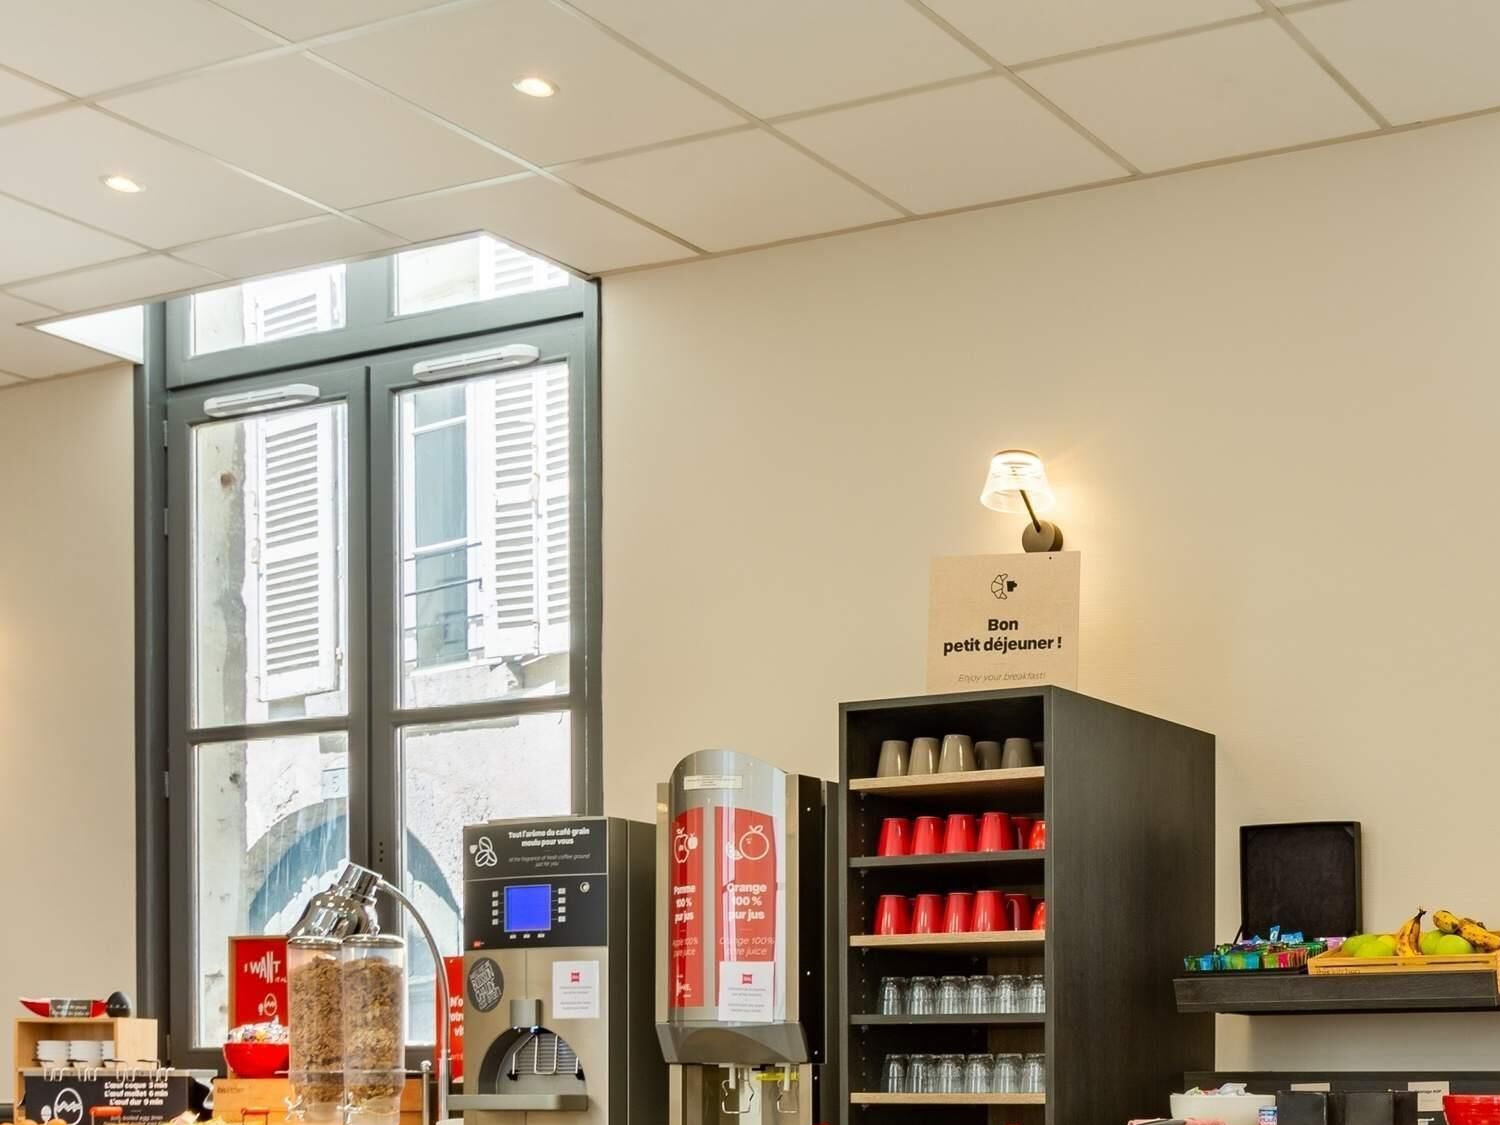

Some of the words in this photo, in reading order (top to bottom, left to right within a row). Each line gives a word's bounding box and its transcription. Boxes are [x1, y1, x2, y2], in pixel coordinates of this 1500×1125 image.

[987, 618, 1019, 632] Bon
[943, 637, 981, 656] petit
[983, 636, 1054, 654] déjeuner
[1057, 636, 1062, 649] !
[958, 673, 981, 683] Enjoy
[983, 672, 1002, 682] your
[546, 828, 555, 837] du
[556, 827, 571, 836] café
[571, 826, 590, 837] grain
[521, 838, 541, 847] moulu
[541, 839, 556, 848] pour
[726, 883, 768, 894] Orange
[747, 909, 765, 922] jus
